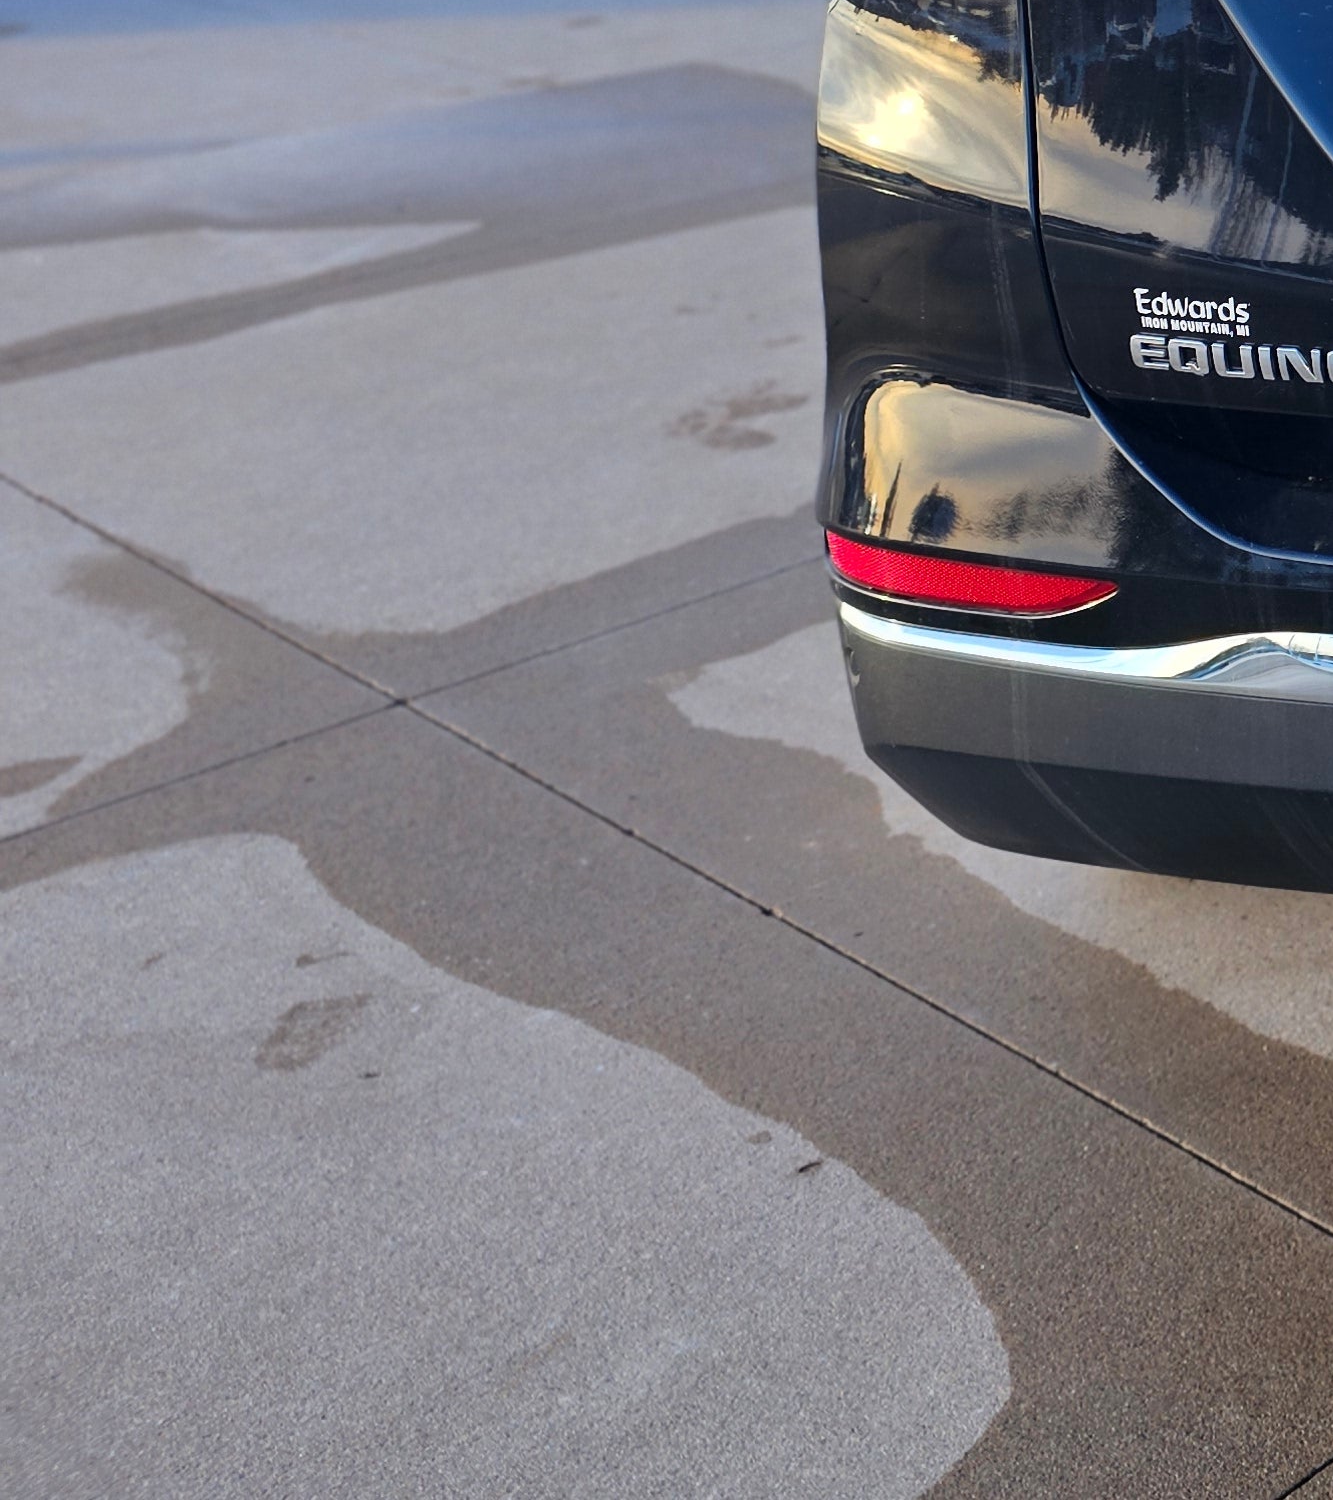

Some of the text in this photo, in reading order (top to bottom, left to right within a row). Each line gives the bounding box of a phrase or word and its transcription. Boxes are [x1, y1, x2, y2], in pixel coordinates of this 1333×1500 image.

[1133, 287, 1250, 324] Edwards
[1140, 316, 1168, 331] IRON
[1236, 324, 1250, 337] MI
